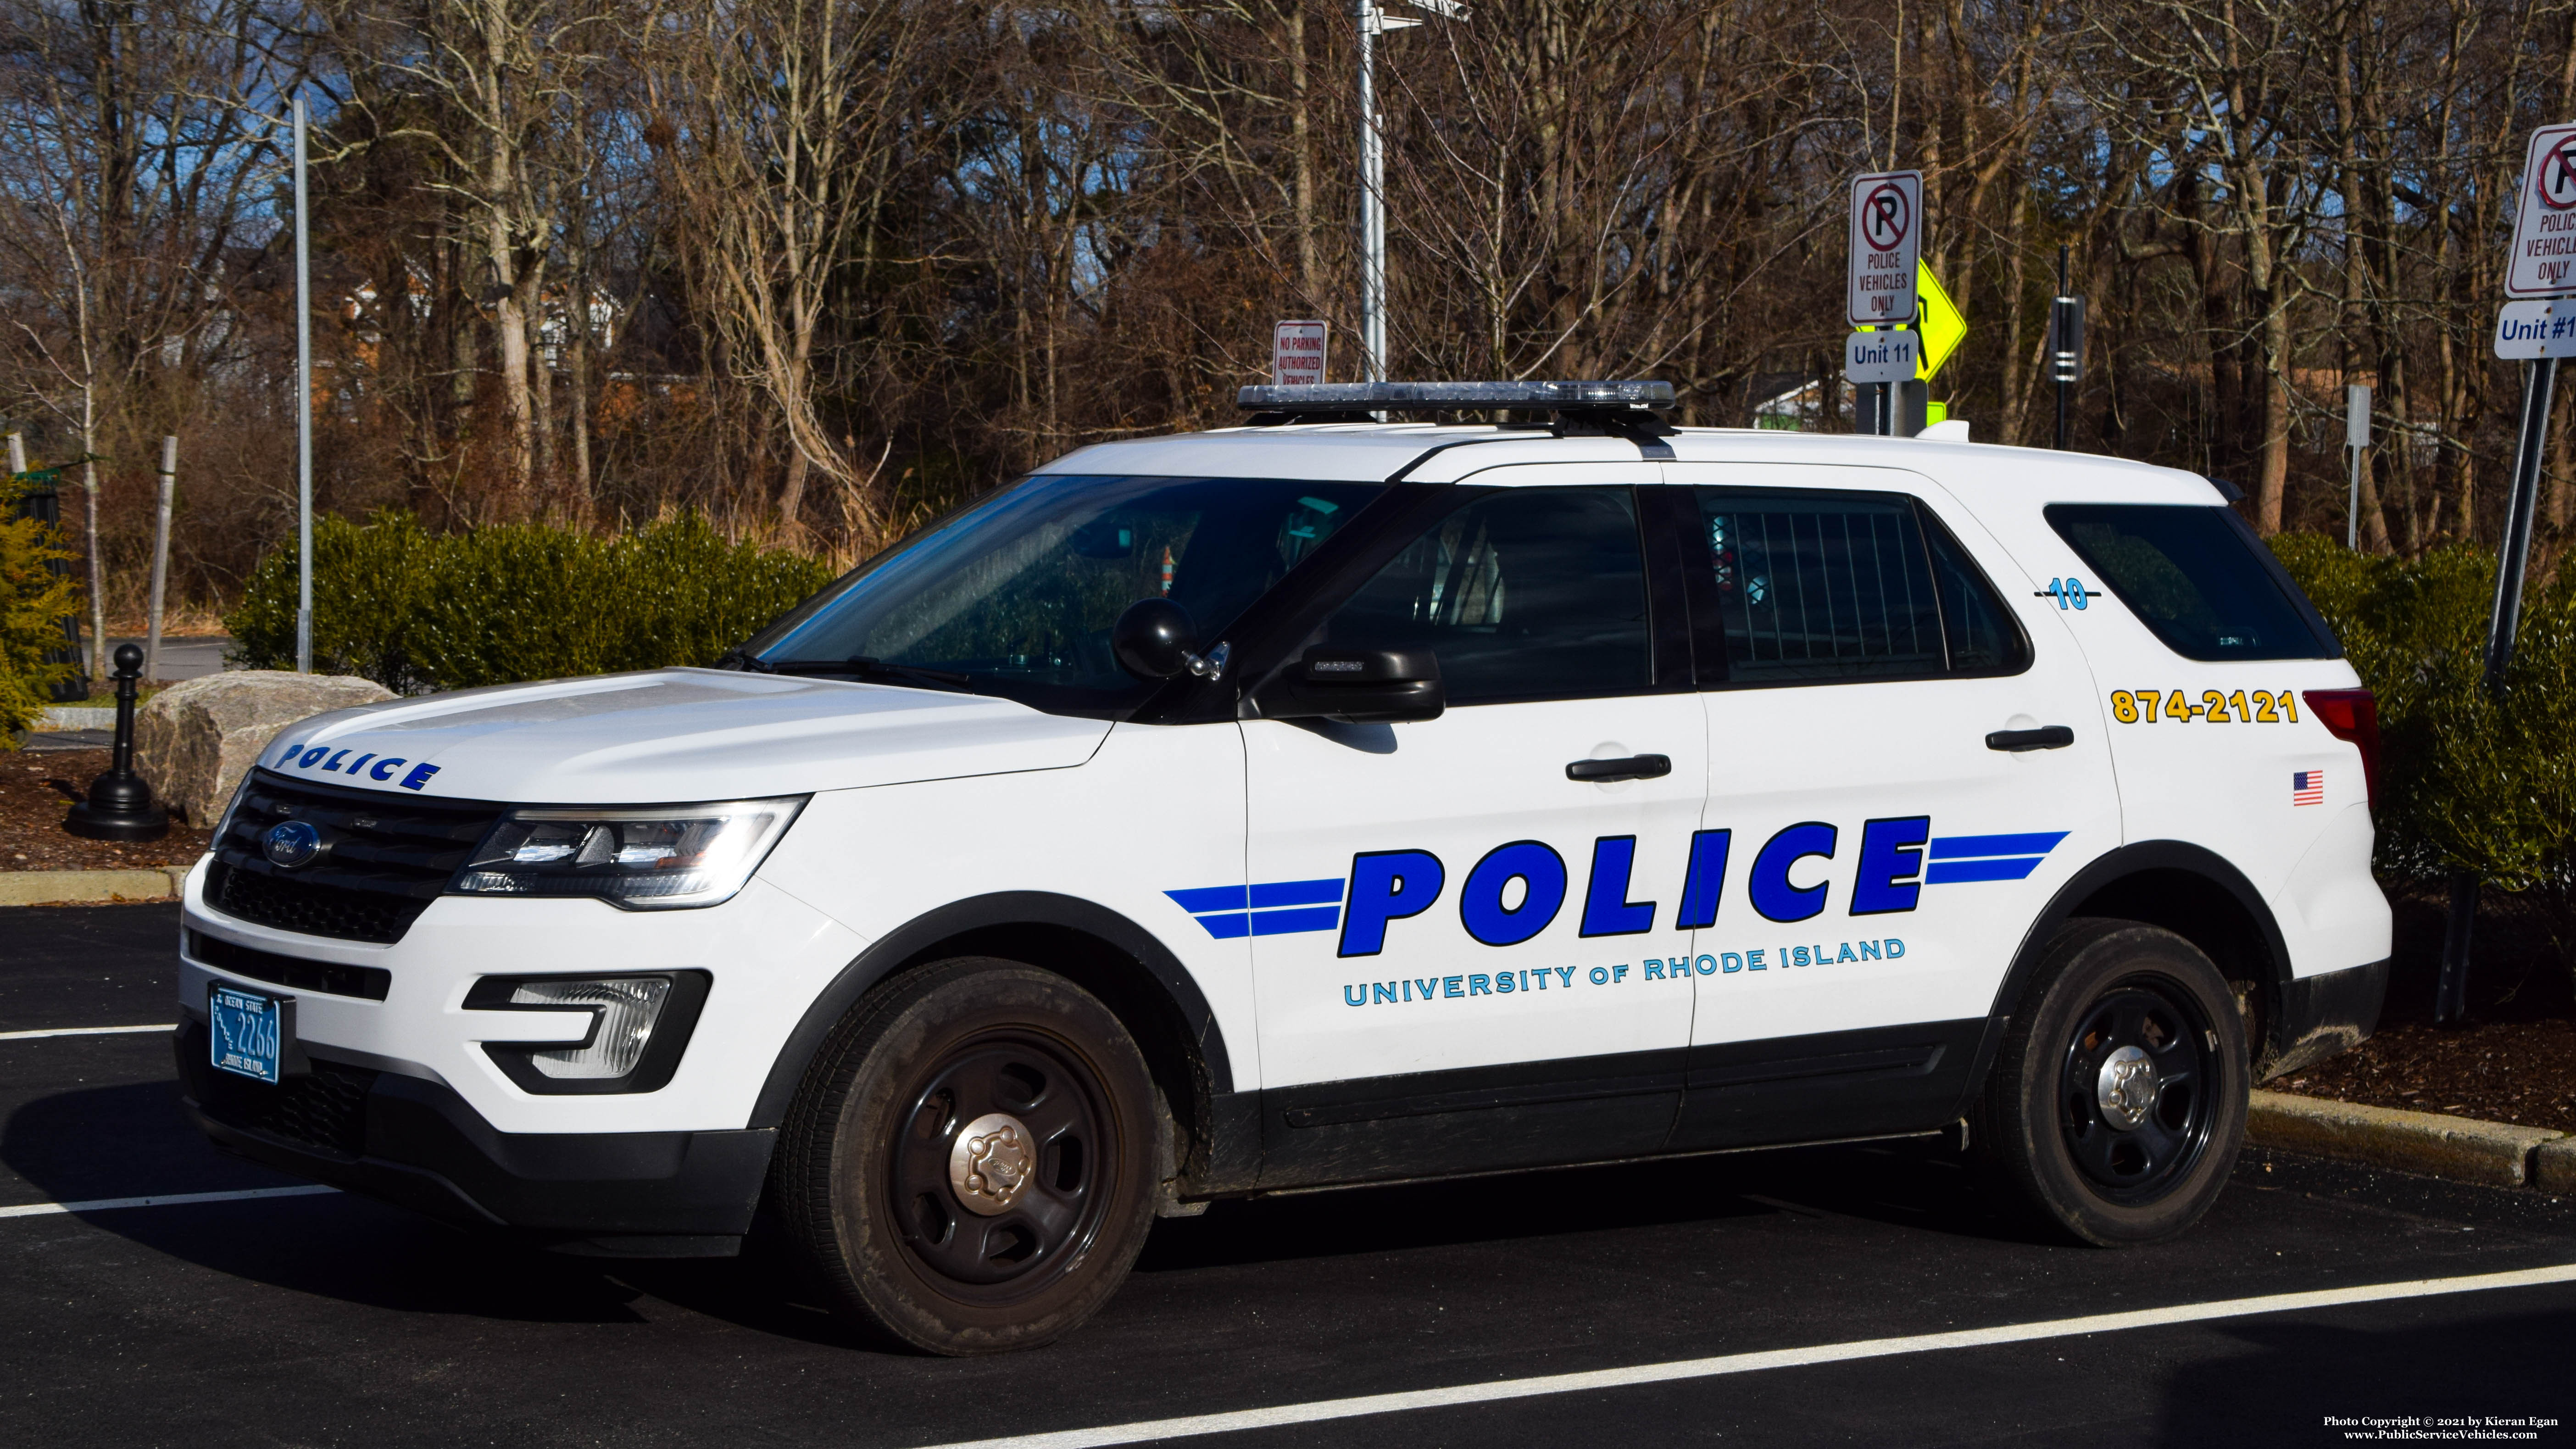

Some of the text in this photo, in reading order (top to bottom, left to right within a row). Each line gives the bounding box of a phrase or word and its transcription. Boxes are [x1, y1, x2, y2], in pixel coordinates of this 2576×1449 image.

[2540, 213, 2576, 232] POLIC
[1868, 253, 1900, 268] POLICE
[2538, 261, 2570, 279] ONLY
[1859, 273, 1907, 291] VEHICLES
[1871, 295, 1894, 312] ONLY
[2502, 319, 2547, 340] Unit
[1281, 338, 1321, 351] NO PARKING
[1854, 343, 1909, 364] Unit 11
[1279, 357, 1320, 369] AUTHORIZED
[2048, 578, 2088, 610] 10
[2110, 690, 2298, 723] 874-2121
[274, 744, 441, 791] POLICE
[270, 826, 301, 854] Ford
[1337, 815, 1931, 959] POLICE
[1344, 938, 1906, 1006] UNIVERSITY OF RHODE ISLAND
[225, 996, 262, 1014] OCEAN STATE
[238, 1012, 274, 1059] 2266
